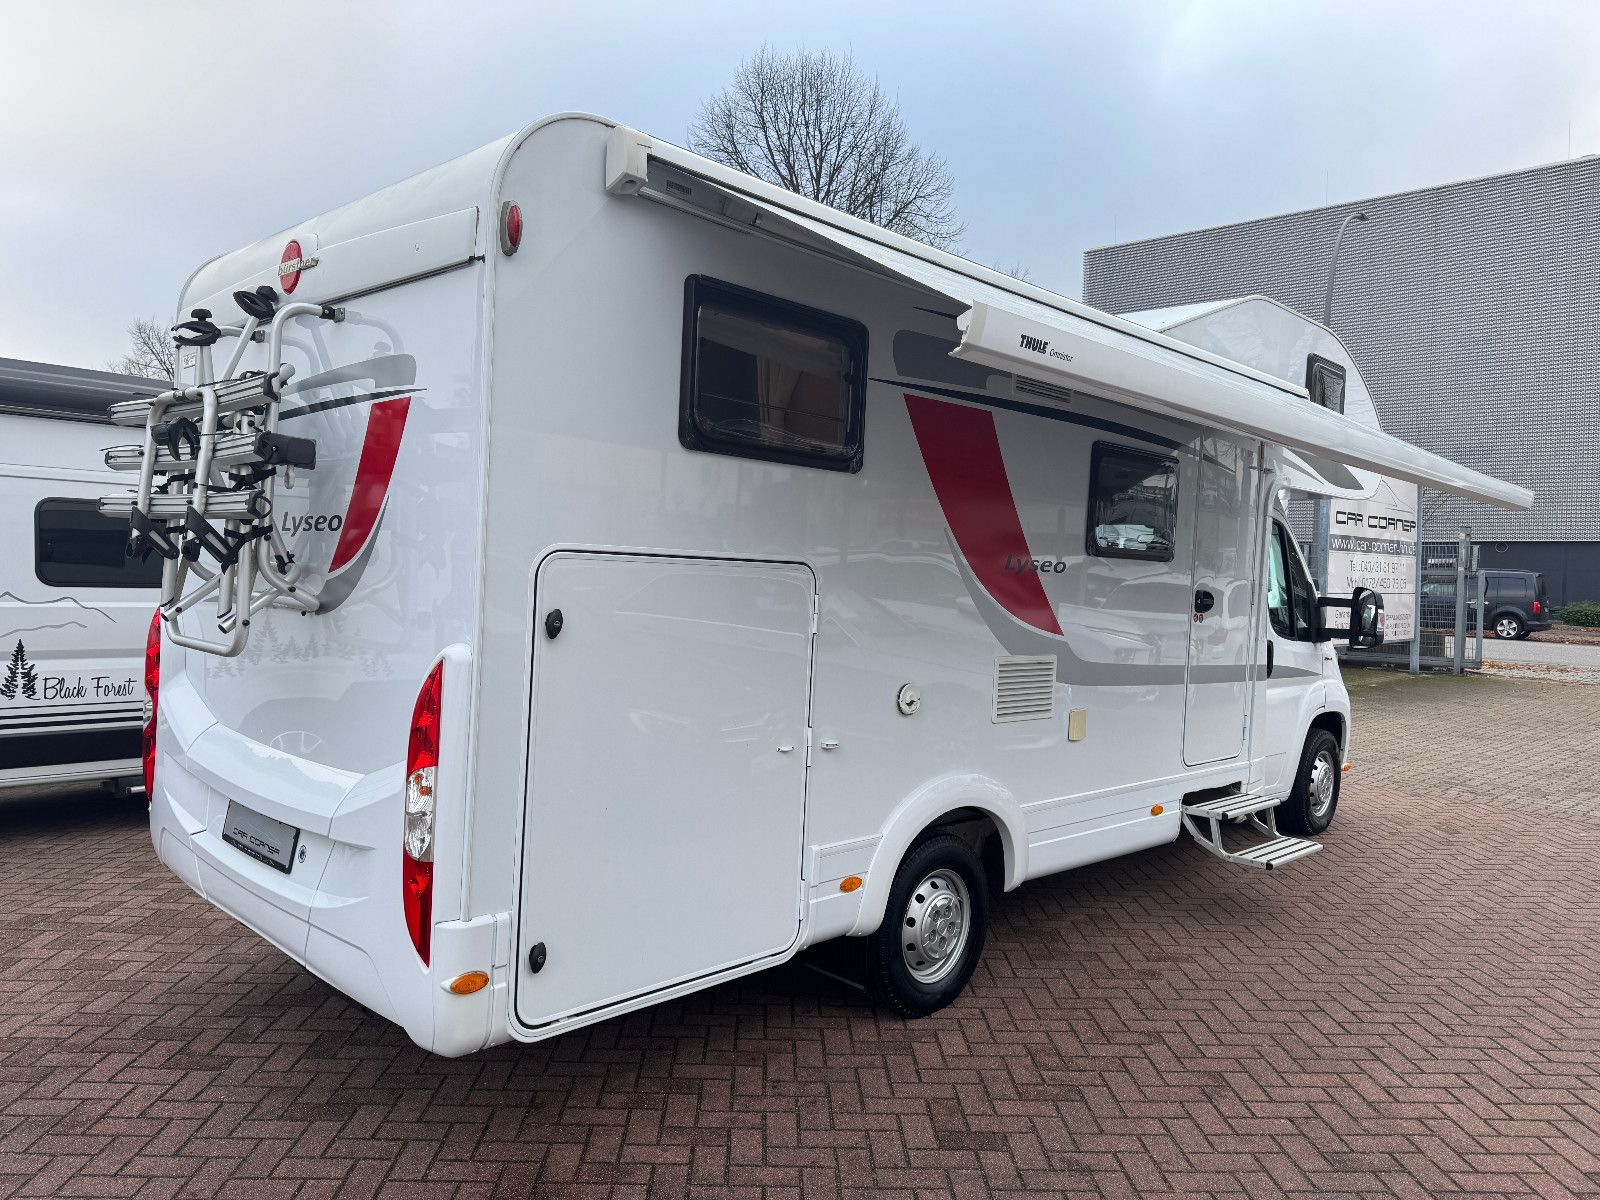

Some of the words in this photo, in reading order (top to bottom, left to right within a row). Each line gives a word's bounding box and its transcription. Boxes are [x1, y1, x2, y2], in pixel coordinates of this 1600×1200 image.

[1020, 333, 1048, 354] THULE
[281, 511, 343, 537] Lyseo
[1335, 510, 1364, 528] CAR
[1367, 515, 1417, 533] CORNER
[1004, 553, 1067, 576] Lyseo
[42, 676, 87, 700] Black
[91, 676, 138, 697] Forest
[232, 827, 249, 840] CAR
